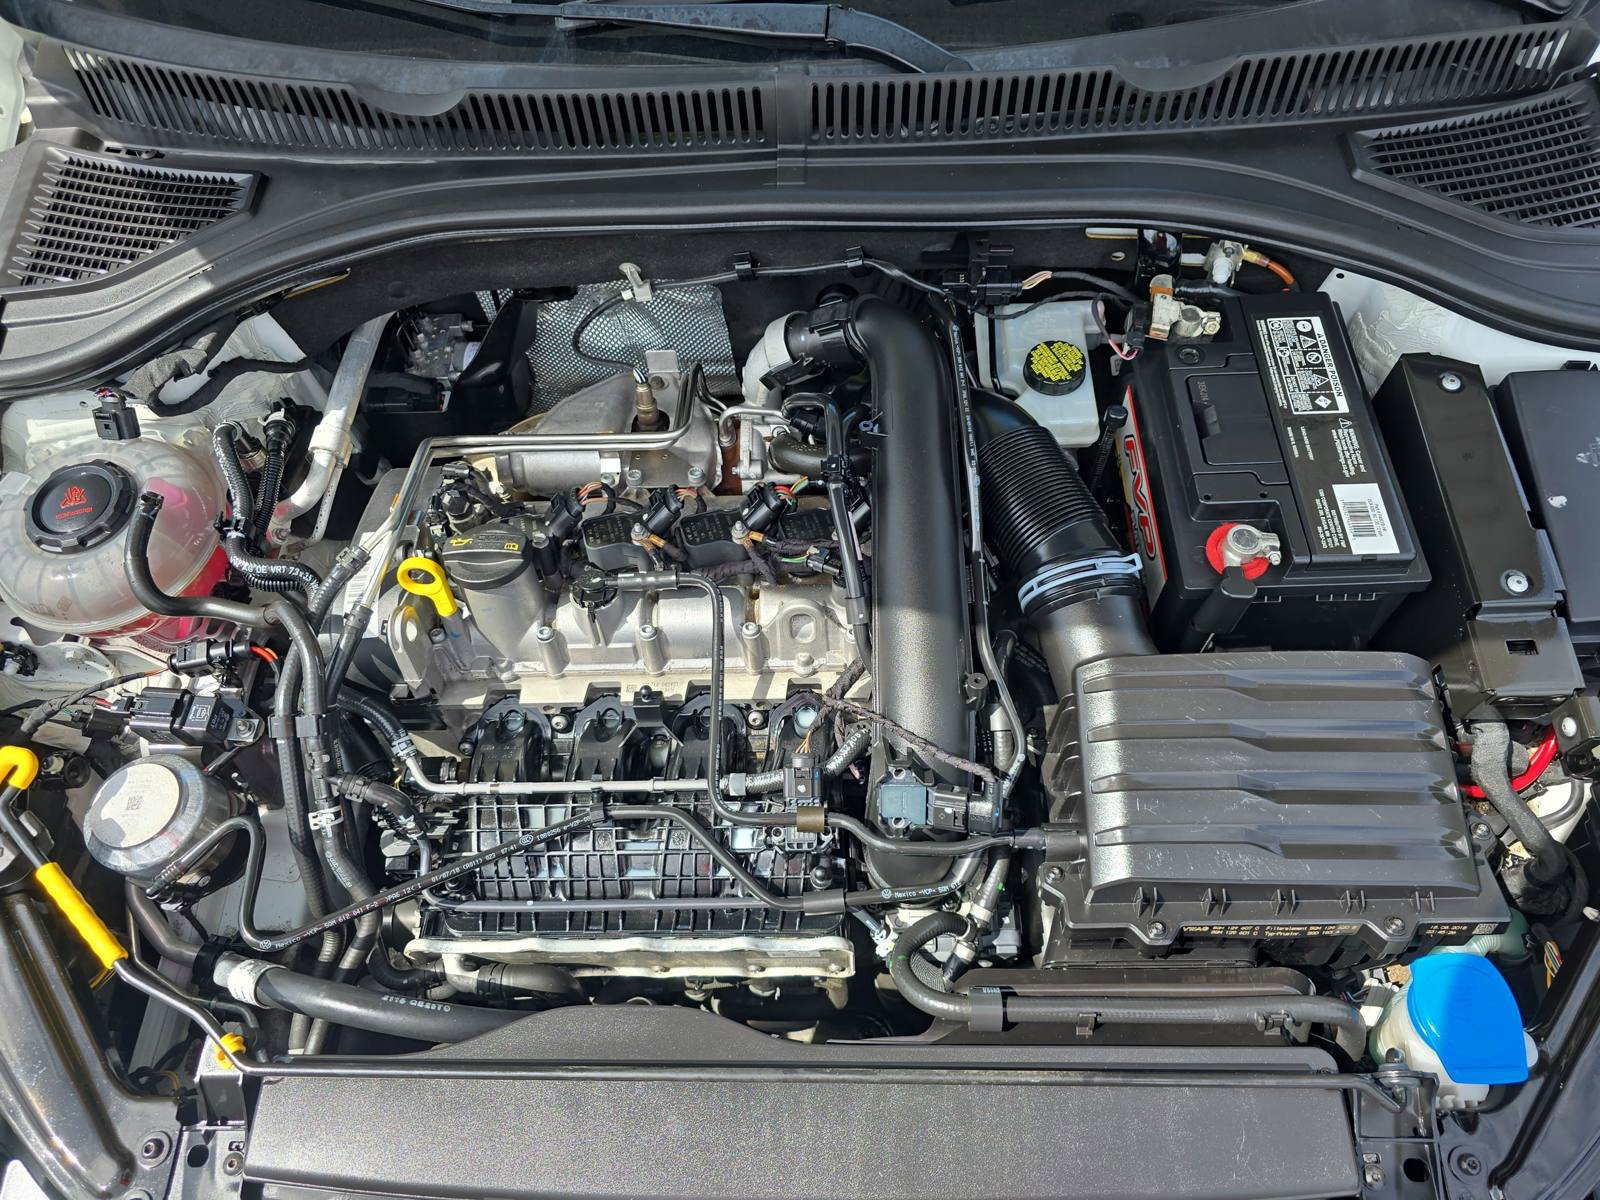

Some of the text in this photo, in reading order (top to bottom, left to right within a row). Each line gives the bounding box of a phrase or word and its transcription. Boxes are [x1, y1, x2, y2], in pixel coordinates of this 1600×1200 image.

[1123, 435, 1157, 559] FVP
[271, 565, 287, 574] VRT
[894, 890, 916, 898] Mexico
[275, 937, 301, 949] Mexico
[338, 913, 350, 923] 612
[353, 909, 363, 917] 041
